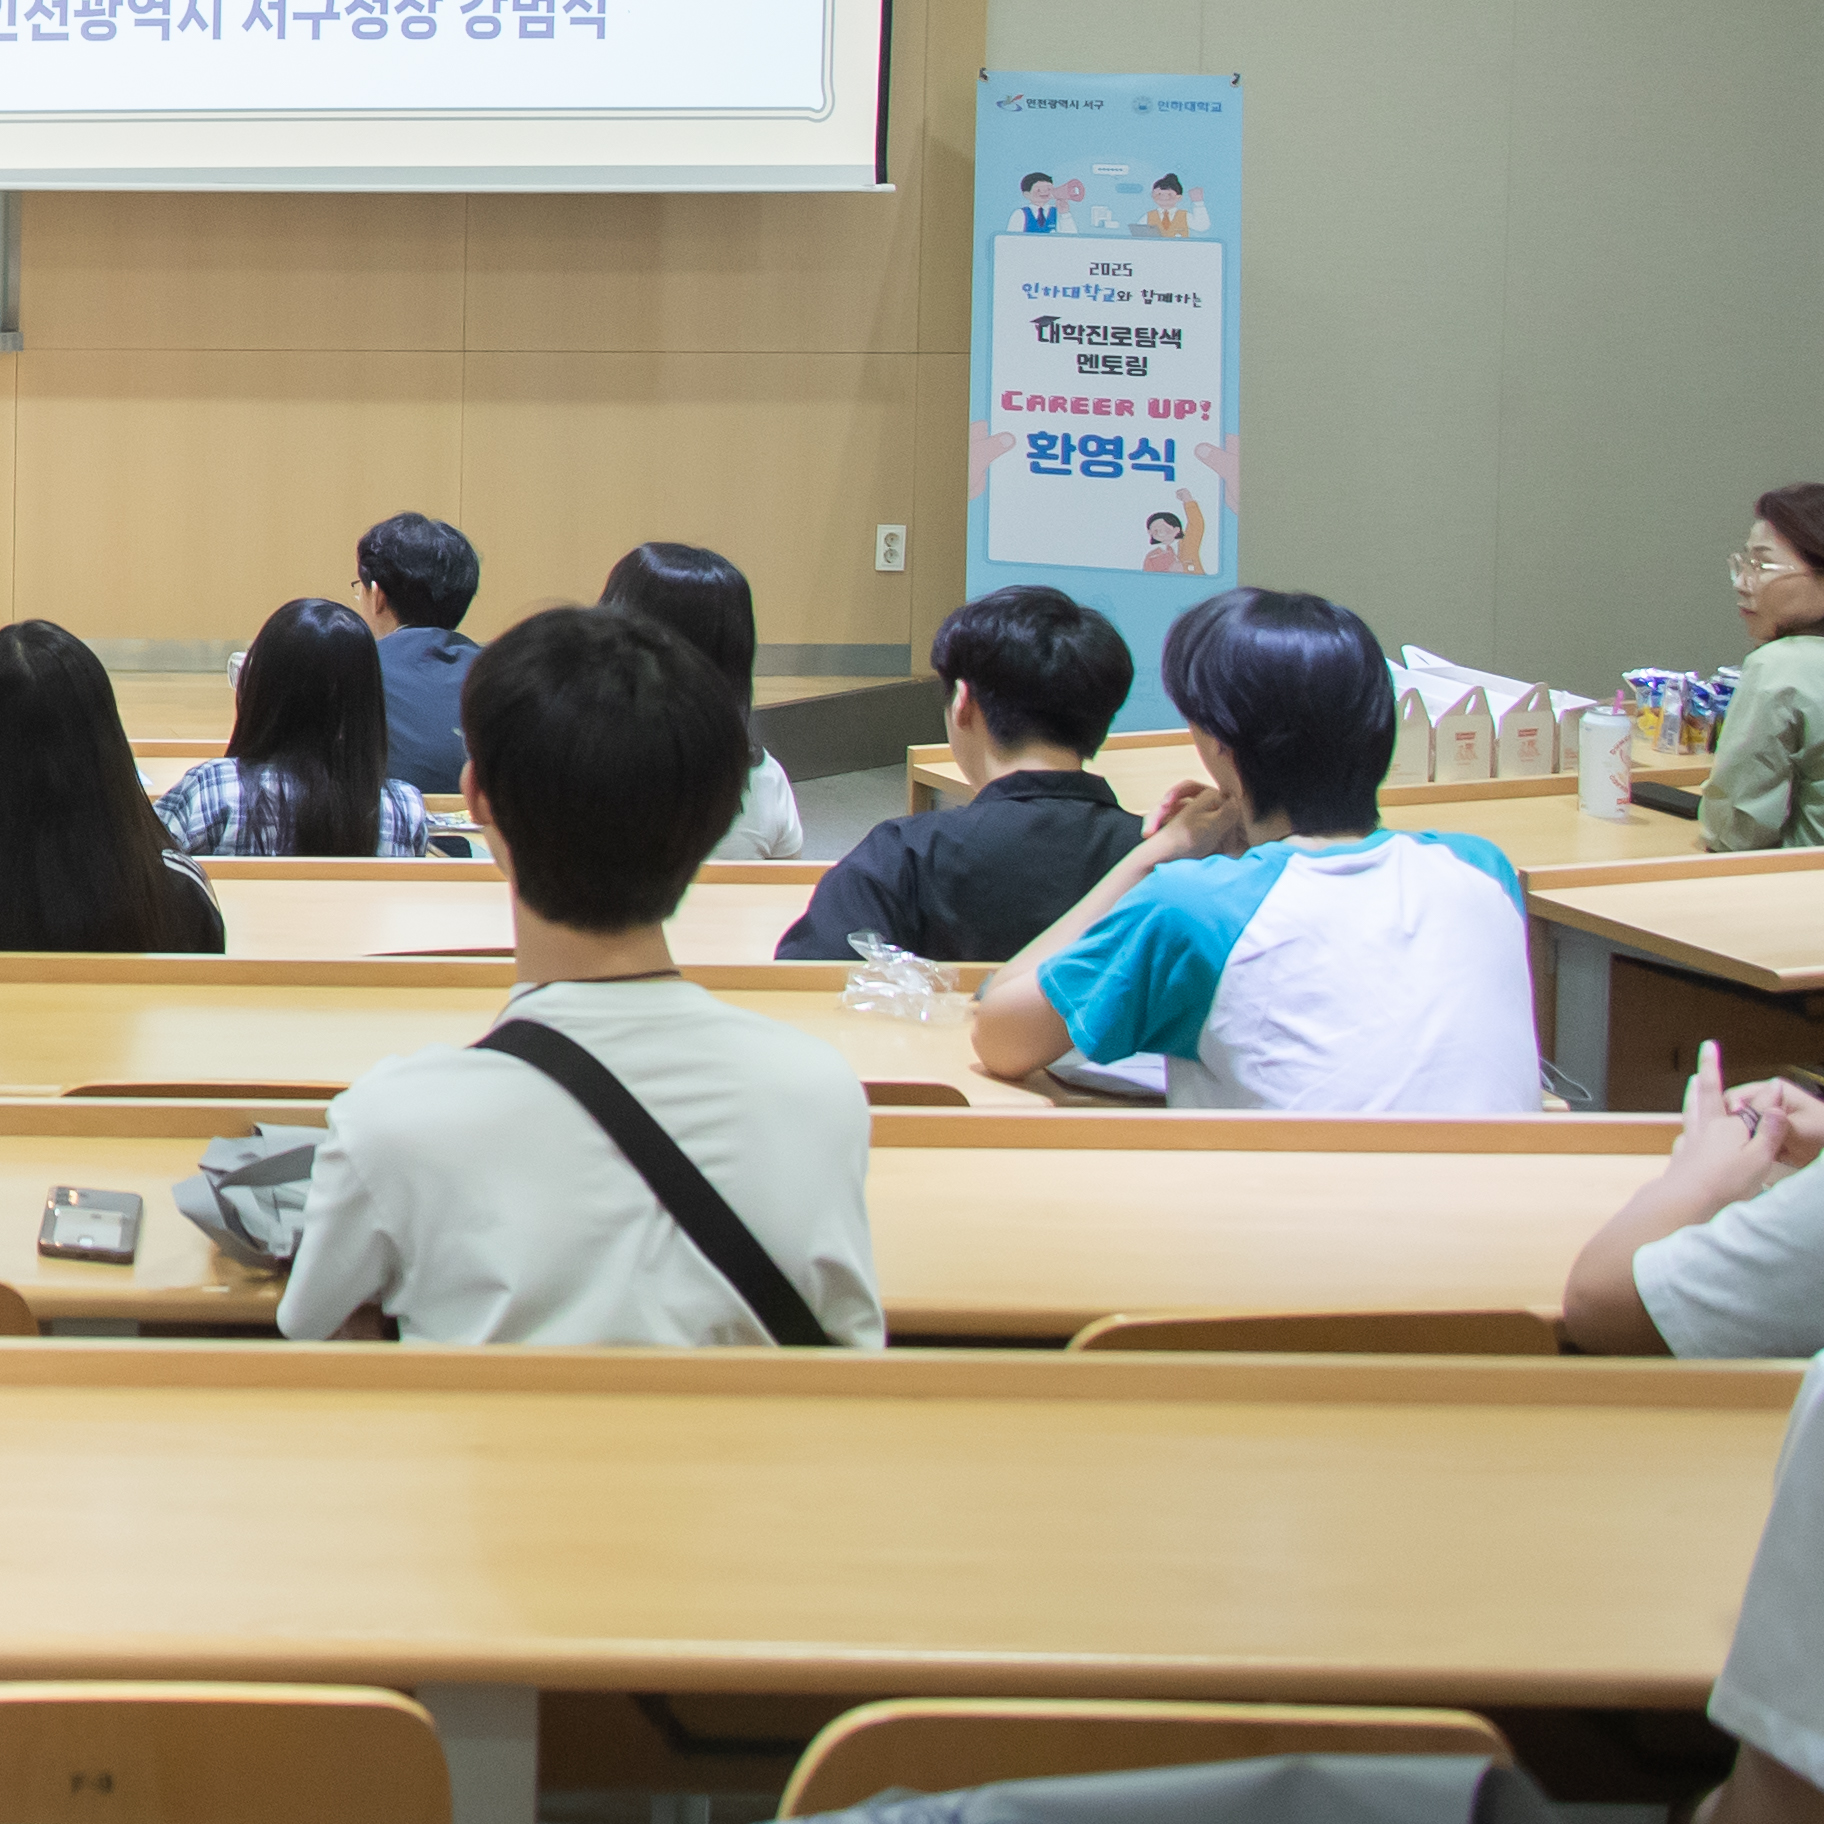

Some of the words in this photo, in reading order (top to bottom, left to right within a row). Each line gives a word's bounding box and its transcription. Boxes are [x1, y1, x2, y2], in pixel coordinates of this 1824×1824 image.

[1089, 262, 1133, 277] 2025
[1021, 282, 1132, 303] 인하대학교와
[1140, 288, 1202, 308] 함께하는
[1036, 323, 1183, 350] 대학진로탐색
[1076, 353, 1148, 377] 멘토링
[1001, 390, 1135, 417] CAREER
[1147, 397, 1212, 422] UP!
[1026, 430, 1176, 483] 환영식
